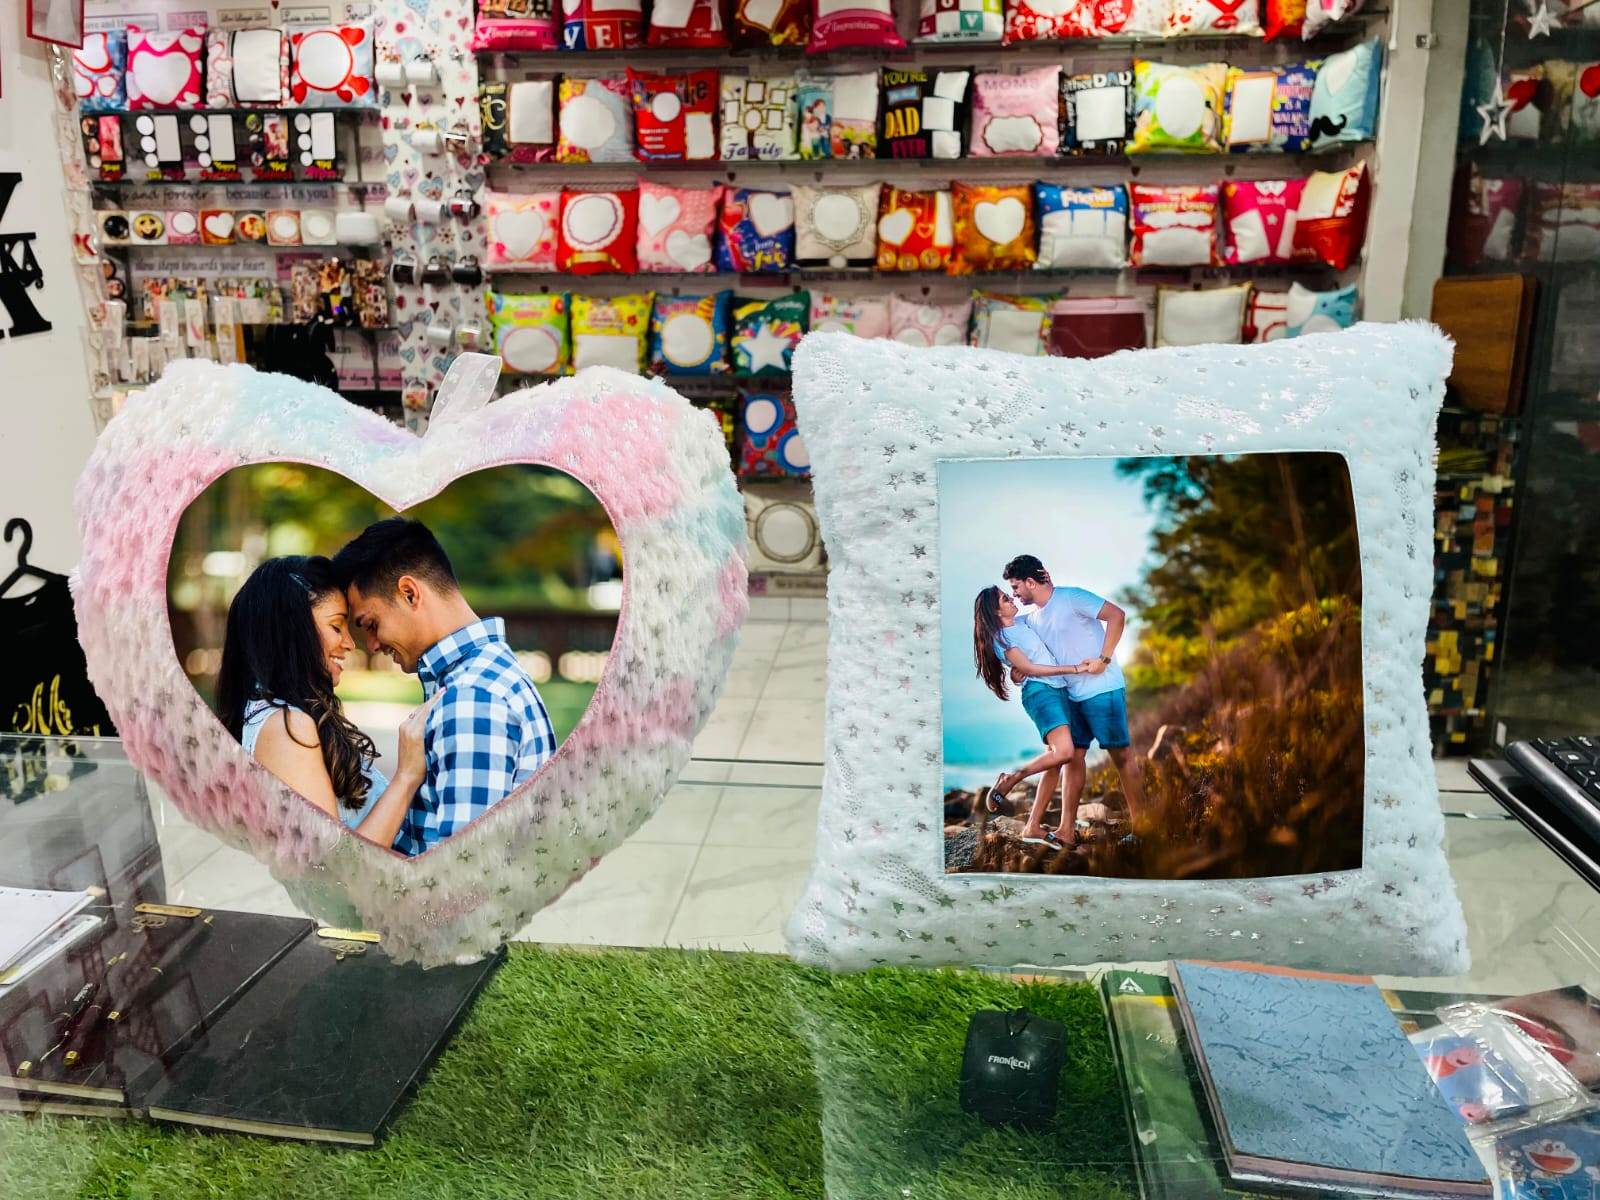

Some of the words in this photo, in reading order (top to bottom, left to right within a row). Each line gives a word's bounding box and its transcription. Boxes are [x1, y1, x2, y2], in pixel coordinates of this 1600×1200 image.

[593, 25, 614, 49] E
[885, 106, 920, 139] DAD
[724, 142, 784, 160] Family
[988, 1055, 1031, 1070] FRONTECH
